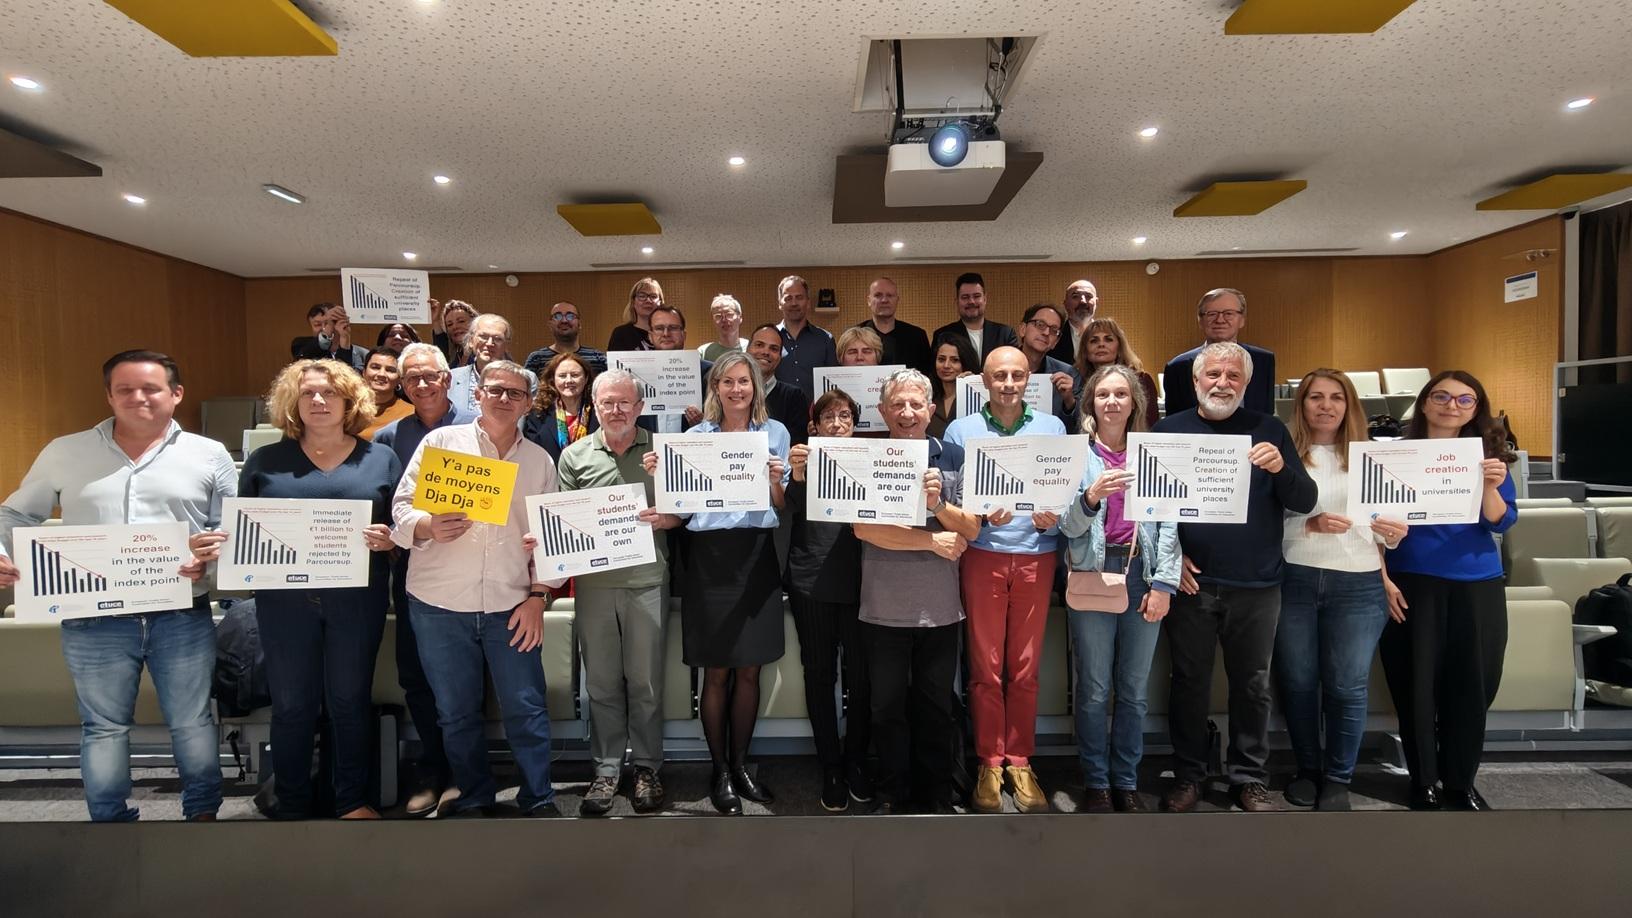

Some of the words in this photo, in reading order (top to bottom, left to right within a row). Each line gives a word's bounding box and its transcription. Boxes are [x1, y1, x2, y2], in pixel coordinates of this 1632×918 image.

[721, 451, 753, 459] Gender
[887, 448, 904, 456] Our
[1199, 447, 1225, 455] Repeal
[1036, 455, 1072, 463] Gender
[1437, 454, 1456, 462] Job
[442, 457, 462, 471] Y'a
[466, 465, 491, 476] pas
[730, 463, 745, 471] pay
[873, 460, 917, 468] students'
[1044, 467, 1062, 476] pay
[1425, 466, 1468, 474] creation
[720, 473, 755, 482] equality
[873, 471, 916, 480] demands
[425, 472, 441, 483] de
[446, 477, 500, 495] moyens
[1033, 478, 1070, 486] equality
[426, 489, 447, 503] Dja
[451, 494, 474, 508] Dja
[608, 494, 625, 502] Our
[597, 503, 638, 515] students'
[599, 515, 640, 526] demands
[622, 526, 636, 535] our
[133, 534, 158, 542] 20%
[613, 538, 631, 546] own
[120, 545, 170, 553] increase
[309, 550, 339, 558] rejected
[112, 557, 123, 565] in
[127, 556, 146, 564] the
[149, 554, 180, 563] value
[130, 567, 141, 575] of
[145, 566, 163, 574] the
[114, 579, 146, 587] index
[150, 576, 180, 587] point
